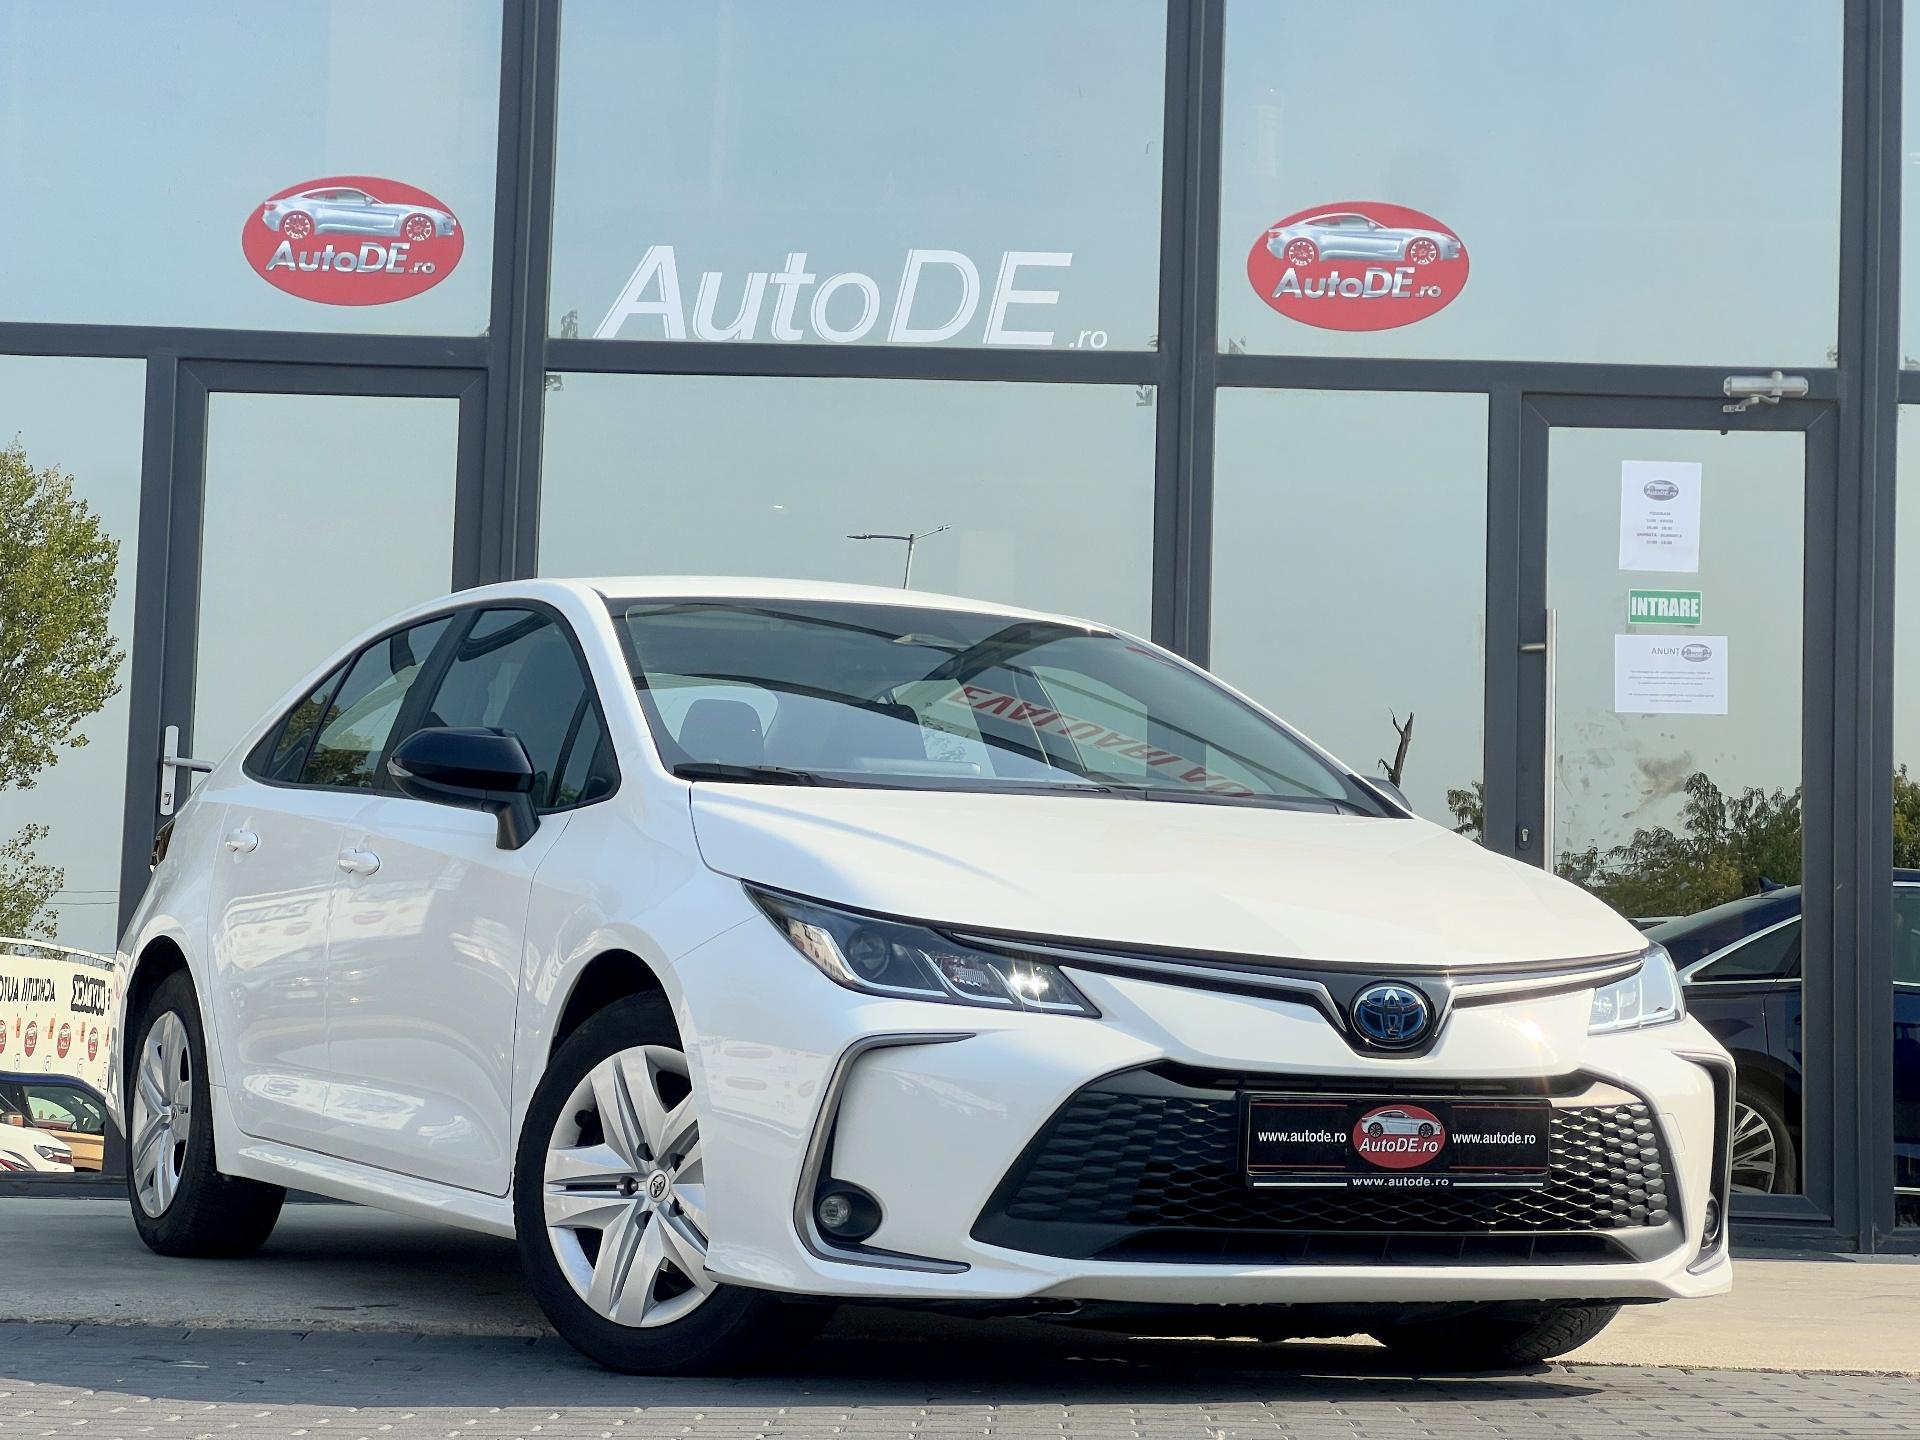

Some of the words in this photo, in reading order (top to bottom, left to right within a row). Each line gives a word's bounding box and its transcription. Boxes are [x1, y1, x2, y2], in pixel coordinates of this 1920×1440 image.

[1631, 596, 1699, 618] INTRARE
[1257, 1129, 1347, 1143] www.autode.ro
[1451, 1131, 1537, 1145] www.autode.ro
[1358, 1137, 1439, 1153] AutoDE.ro
[1352, 1175, 1449, 1187] www.autode.ro
